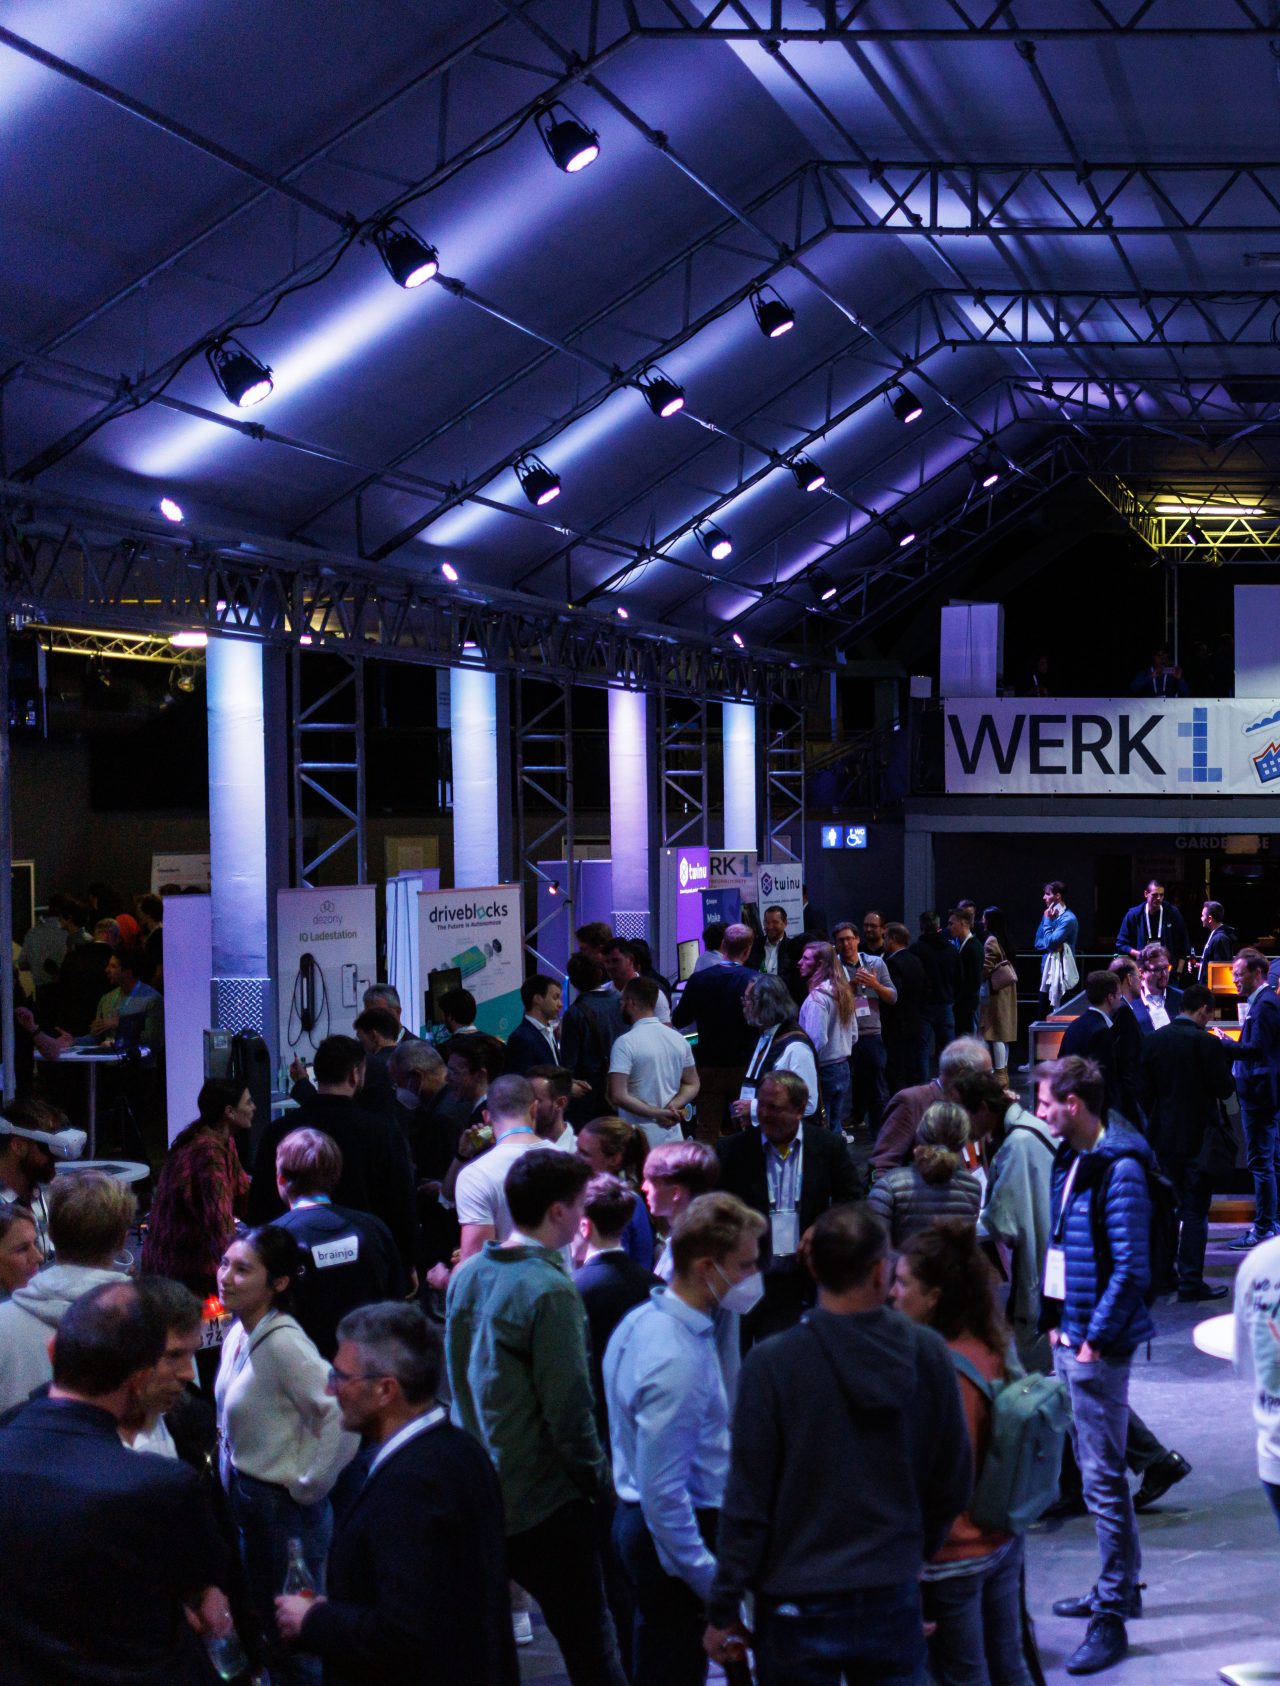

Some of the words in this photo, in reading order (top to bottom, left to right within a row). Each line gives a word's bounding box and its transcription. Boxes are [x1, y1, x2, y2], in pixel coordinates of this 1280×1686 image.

[947, 714, 1166, 775] WERK
[1177, 707, 1223, 783] 1
[1176, 836, 1270, 849] GARDEE
[689, 862, 707, 880] twinu
[709, 856, 736, 875] RK
[774, 876, 801, 891] twinu
[429, 902, 508, 922] driveblocks
[299, 932, 309, 942] IQ
[310, 929, 357, 942] Ladestation
[317, 1248, 354, 1261] brainjo
